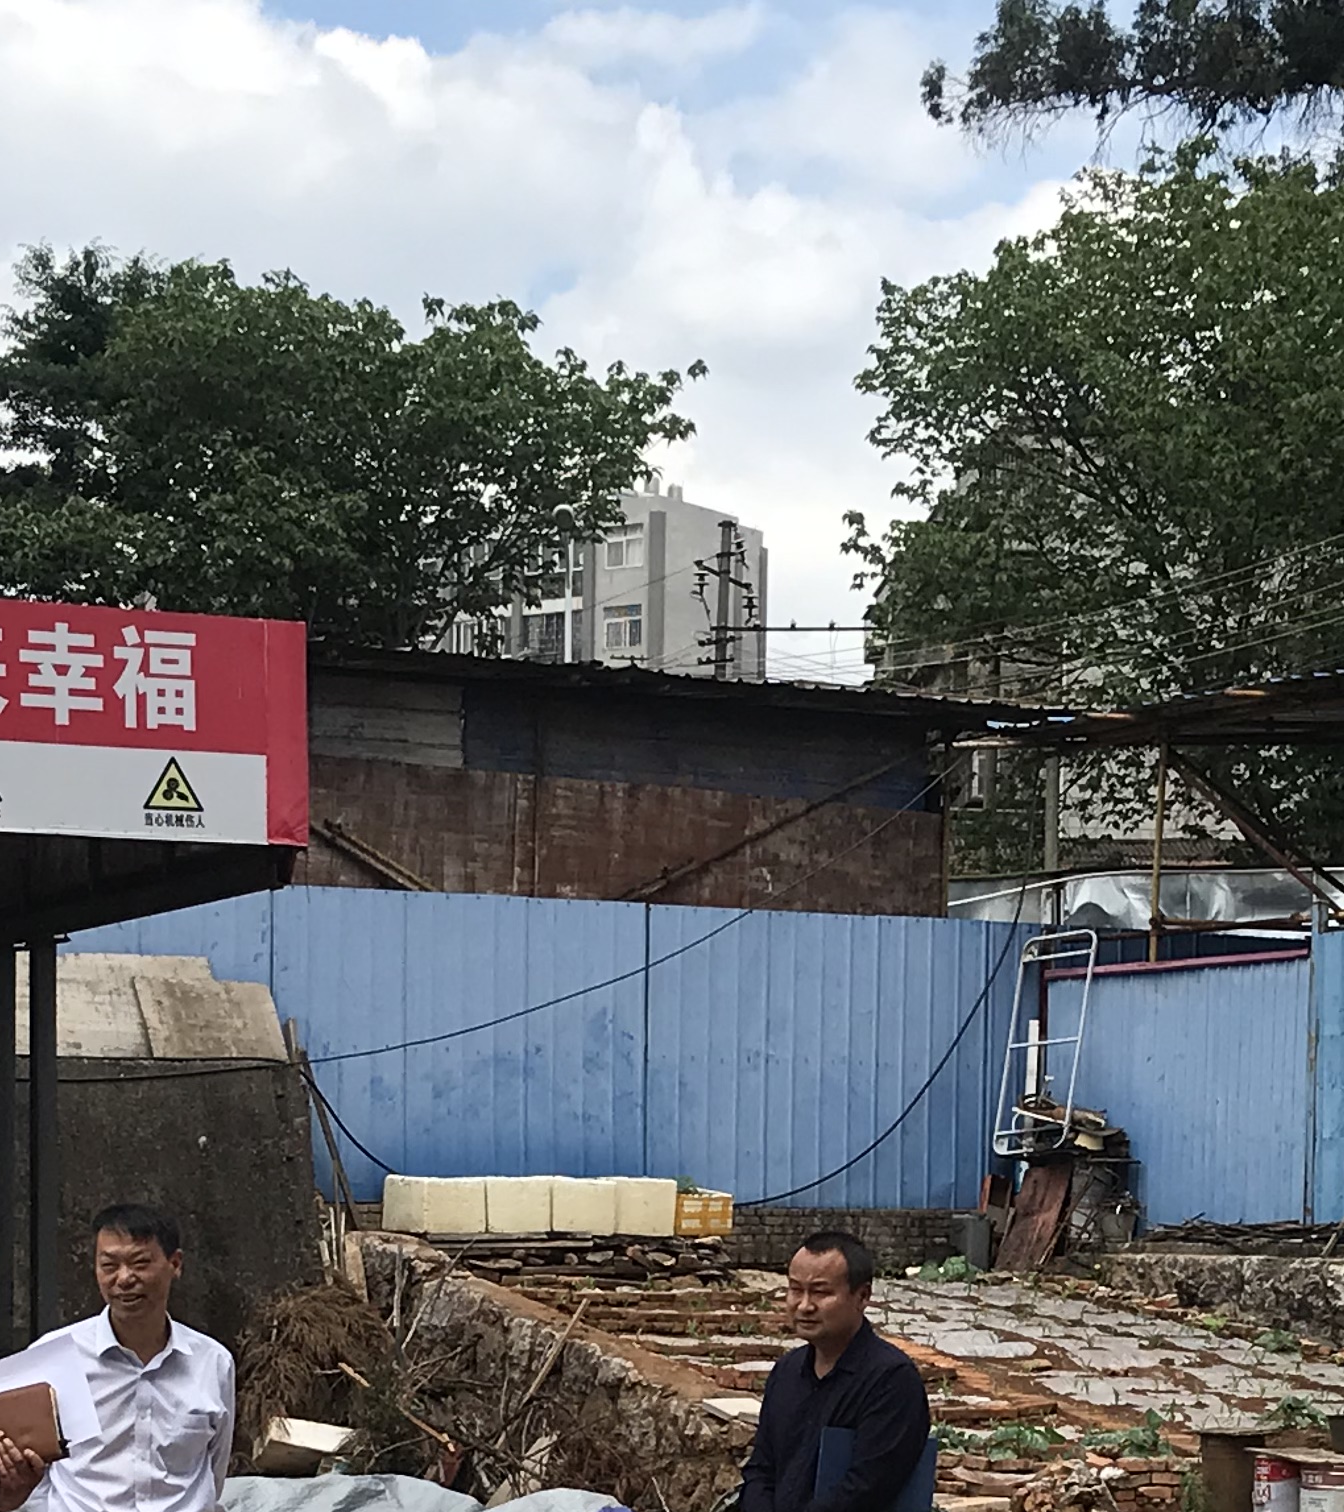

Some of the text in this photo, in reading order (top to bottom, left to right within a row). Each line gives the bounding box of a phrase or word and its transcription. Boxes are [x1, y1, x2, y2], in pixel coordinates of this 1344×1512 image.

[144, 812, 206, 829] 当心机械伤人
